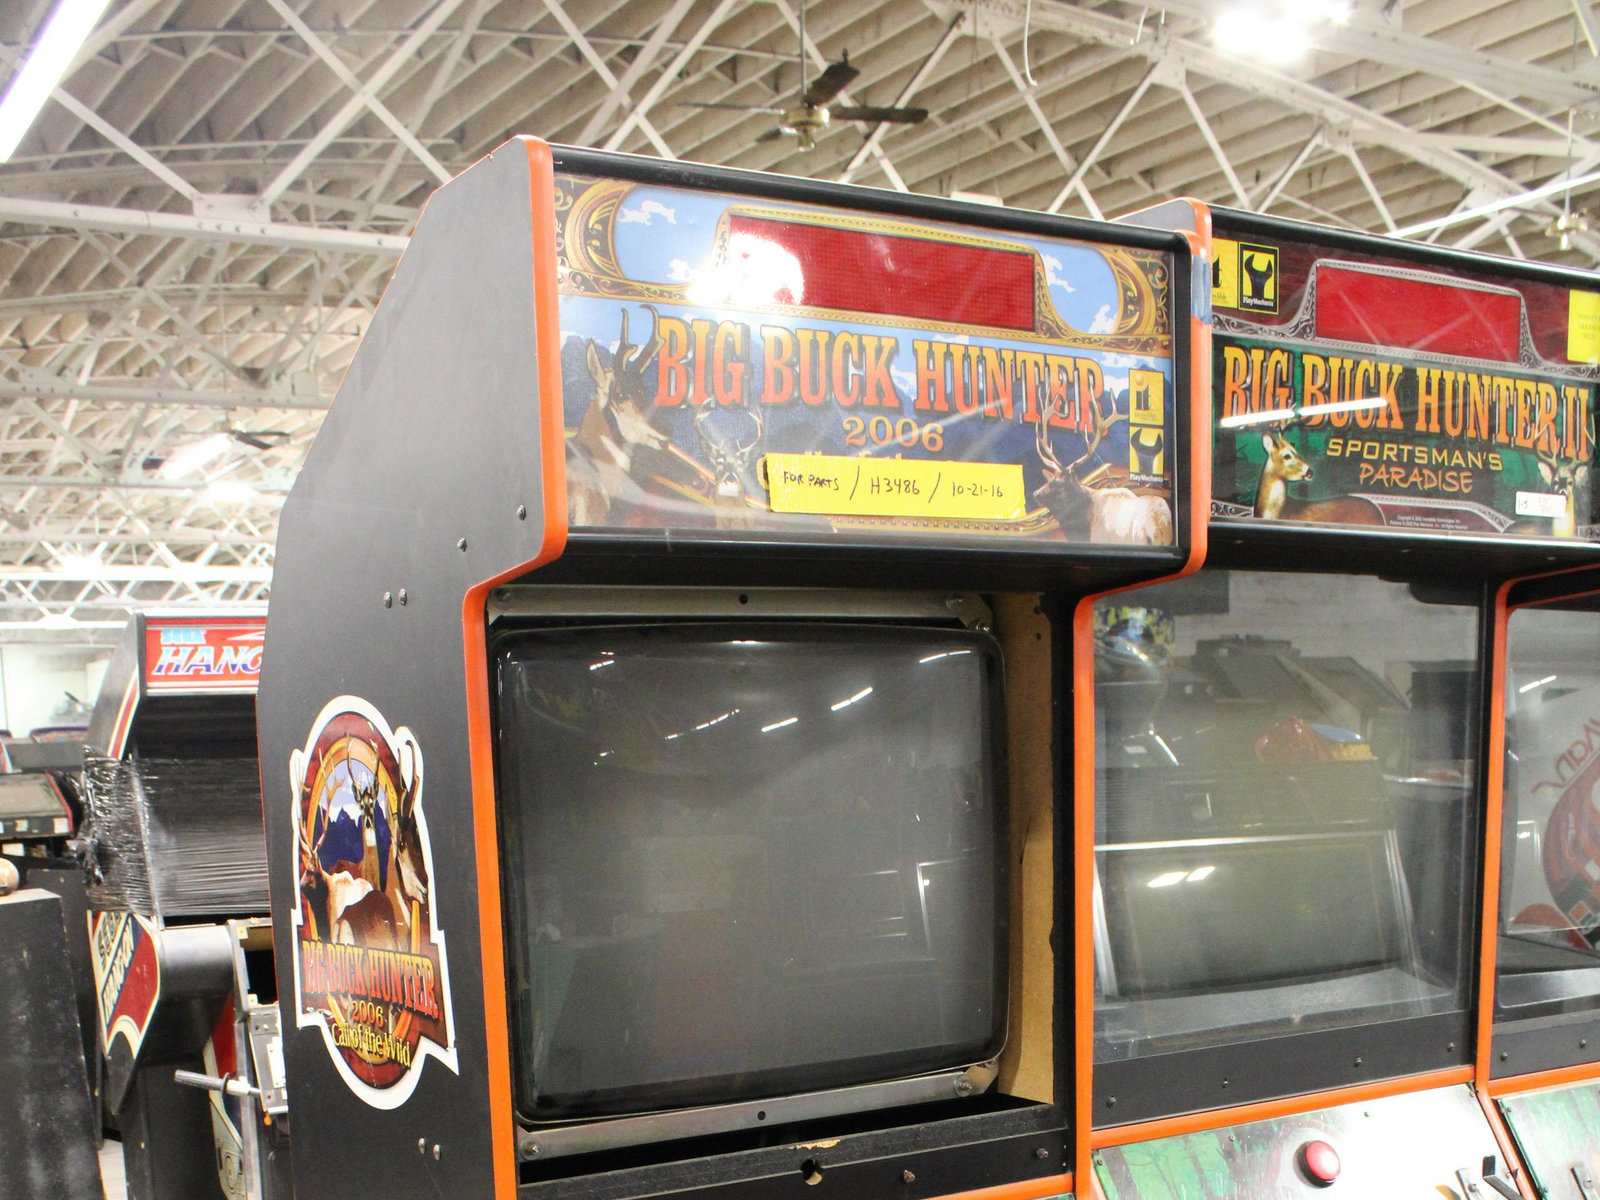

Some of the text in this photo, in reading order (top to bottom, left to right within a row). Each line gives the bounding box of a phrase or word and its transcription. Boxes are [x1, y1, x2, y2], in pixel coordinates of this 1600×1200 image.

[654, 316, 1109, 437] BIG BUCK HUNTER
[1223, 346, 1290, 428] BIG
[1302, 354, 1405, 430] BUCK
[1415, 366, 1560, 456] HUNTER
[842, 415, 945, 452] 2006
[1326, 438, 1503, 471] SPORTSMAN'S
[782, 470, 805, 485] FOR
[808, 473, 839, 491] PARTS
[869, 476, 920, 496] H3486
[952, 485, 1004, 498] 10-21-16
[1359, 462, 1473, 494] PARADISE
[302, 939, 439, 1019] BIG BUCK HUNTER
[351, 1000, 384, 1028] 2006
